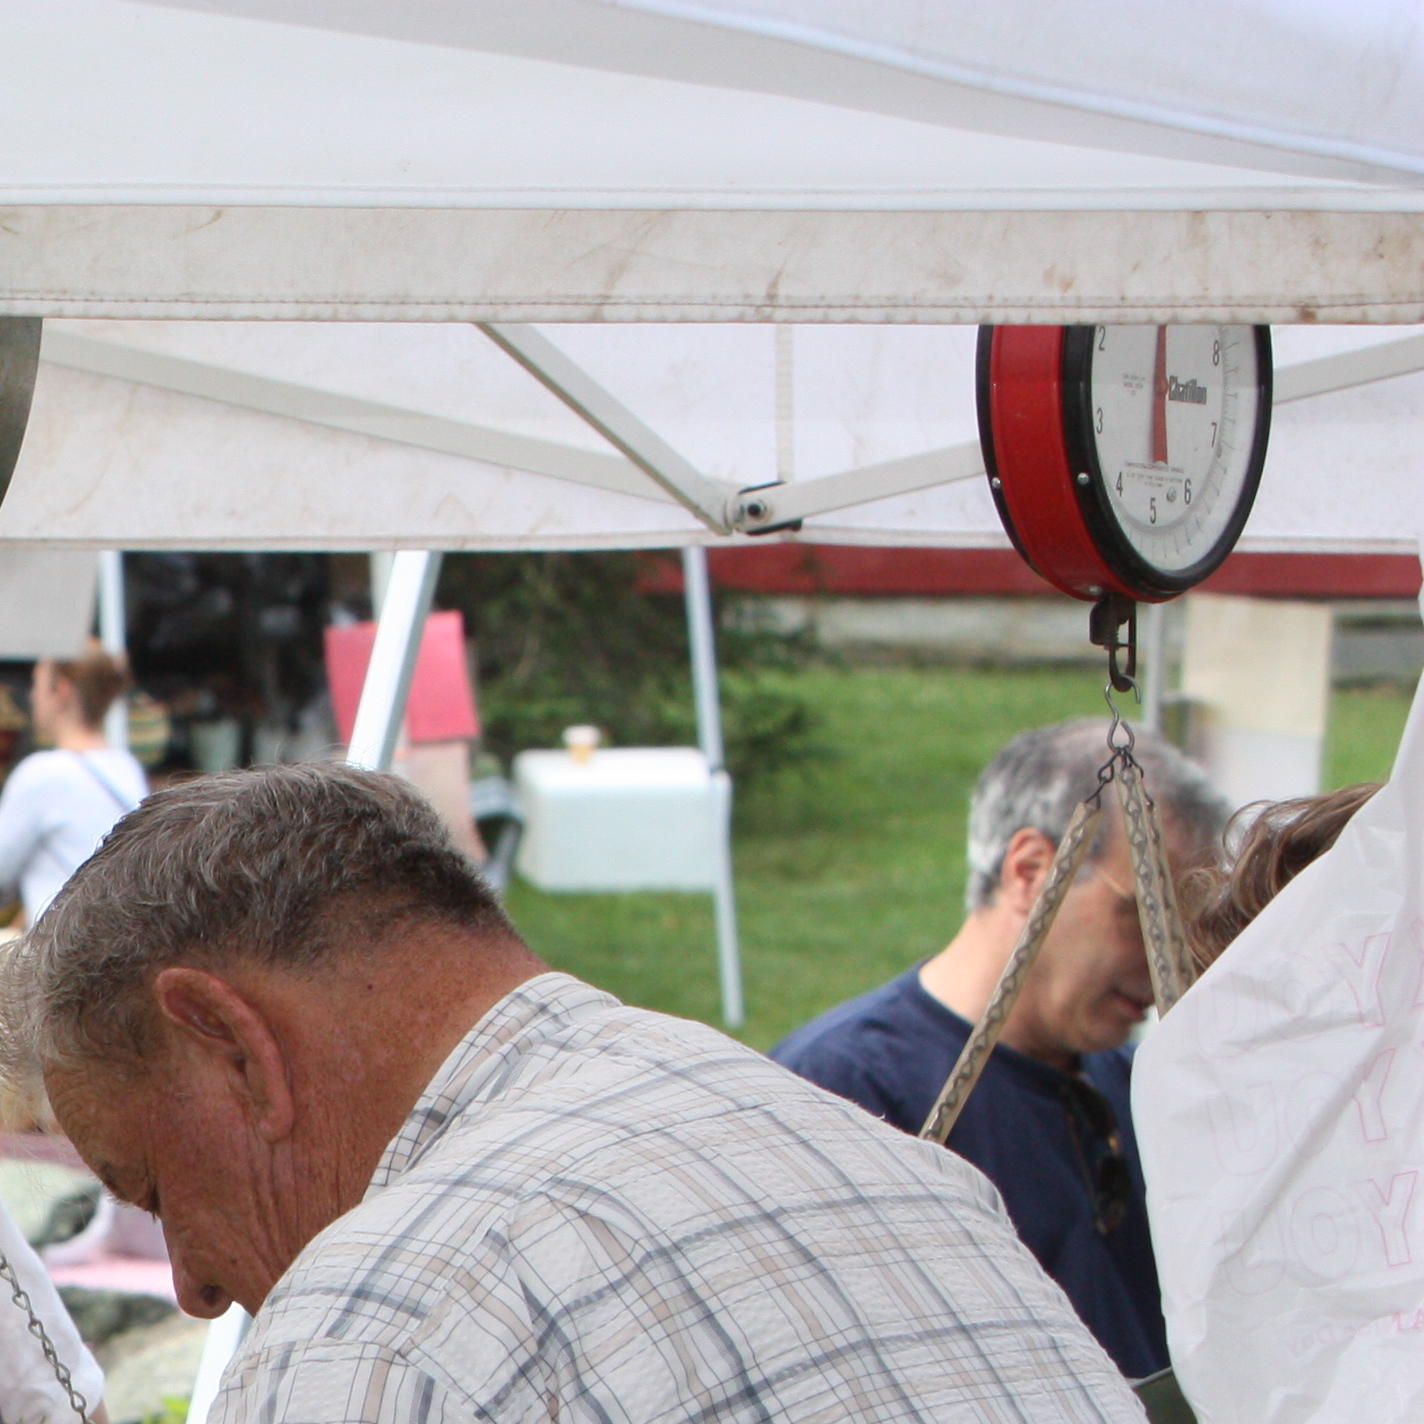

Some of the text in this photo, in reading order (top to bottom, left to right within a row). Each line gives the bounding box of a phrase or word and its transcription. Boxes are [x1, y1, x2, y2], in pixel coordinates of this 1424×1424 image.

[1098, 325, 1107, 352] 2
[1212, 340, 1220, 367] 8
[1096, 407, 1104, 435] 3
[1211, 422, 1218, 448] 7
[1116, 471, 1124, 498] 4
[1184, 478, 1192, 505] 6
[1149, 497, 1157, 525] 5
